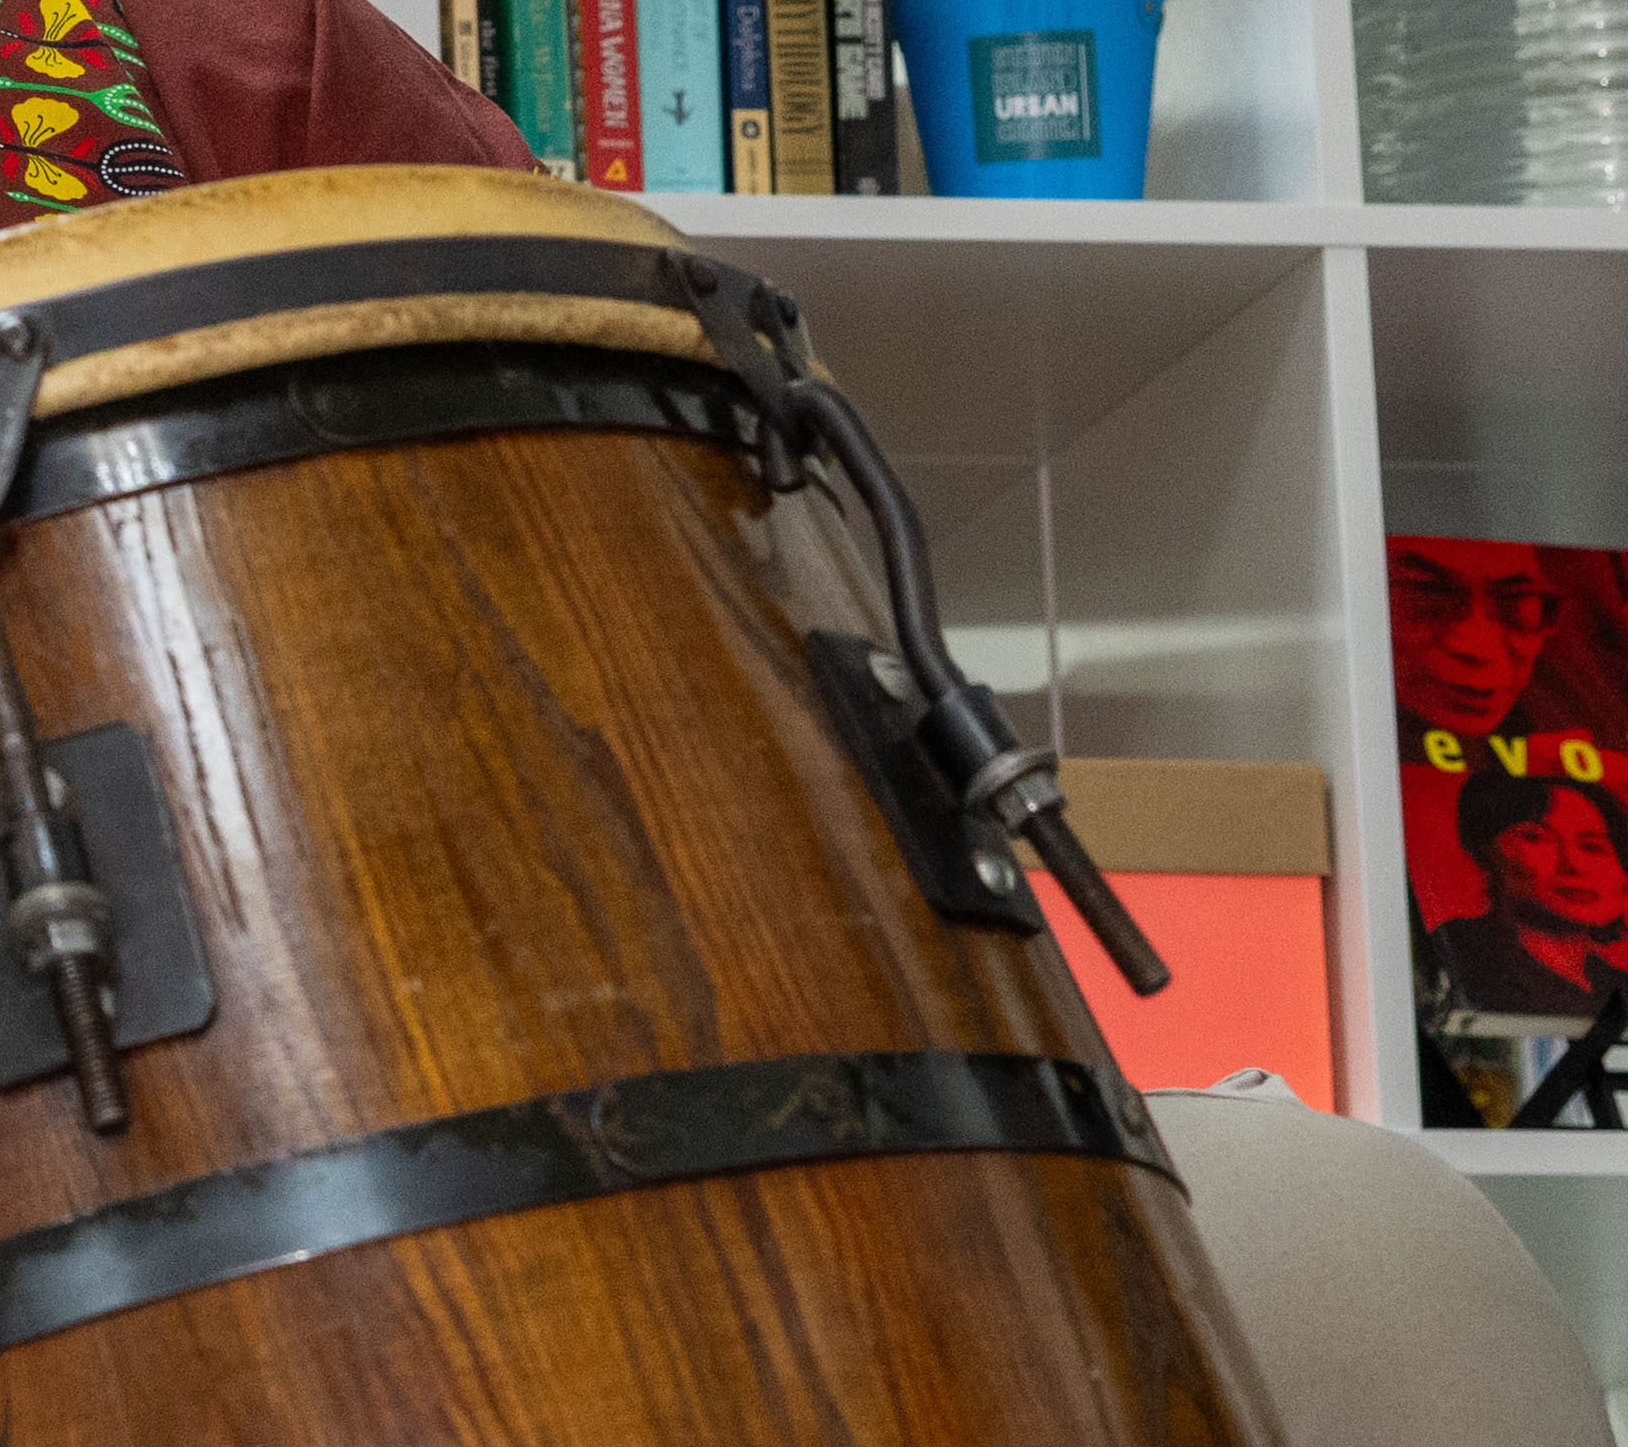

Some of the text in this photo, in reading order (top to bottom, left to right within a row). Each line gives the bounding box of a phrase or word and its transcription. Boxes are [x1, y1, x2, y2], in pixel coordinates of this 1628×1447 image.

[600, 37, 628, 128] WOMEN
[732, 5, 758, 90] Dolphins
[994, 94, 1079, 121] URBAN
